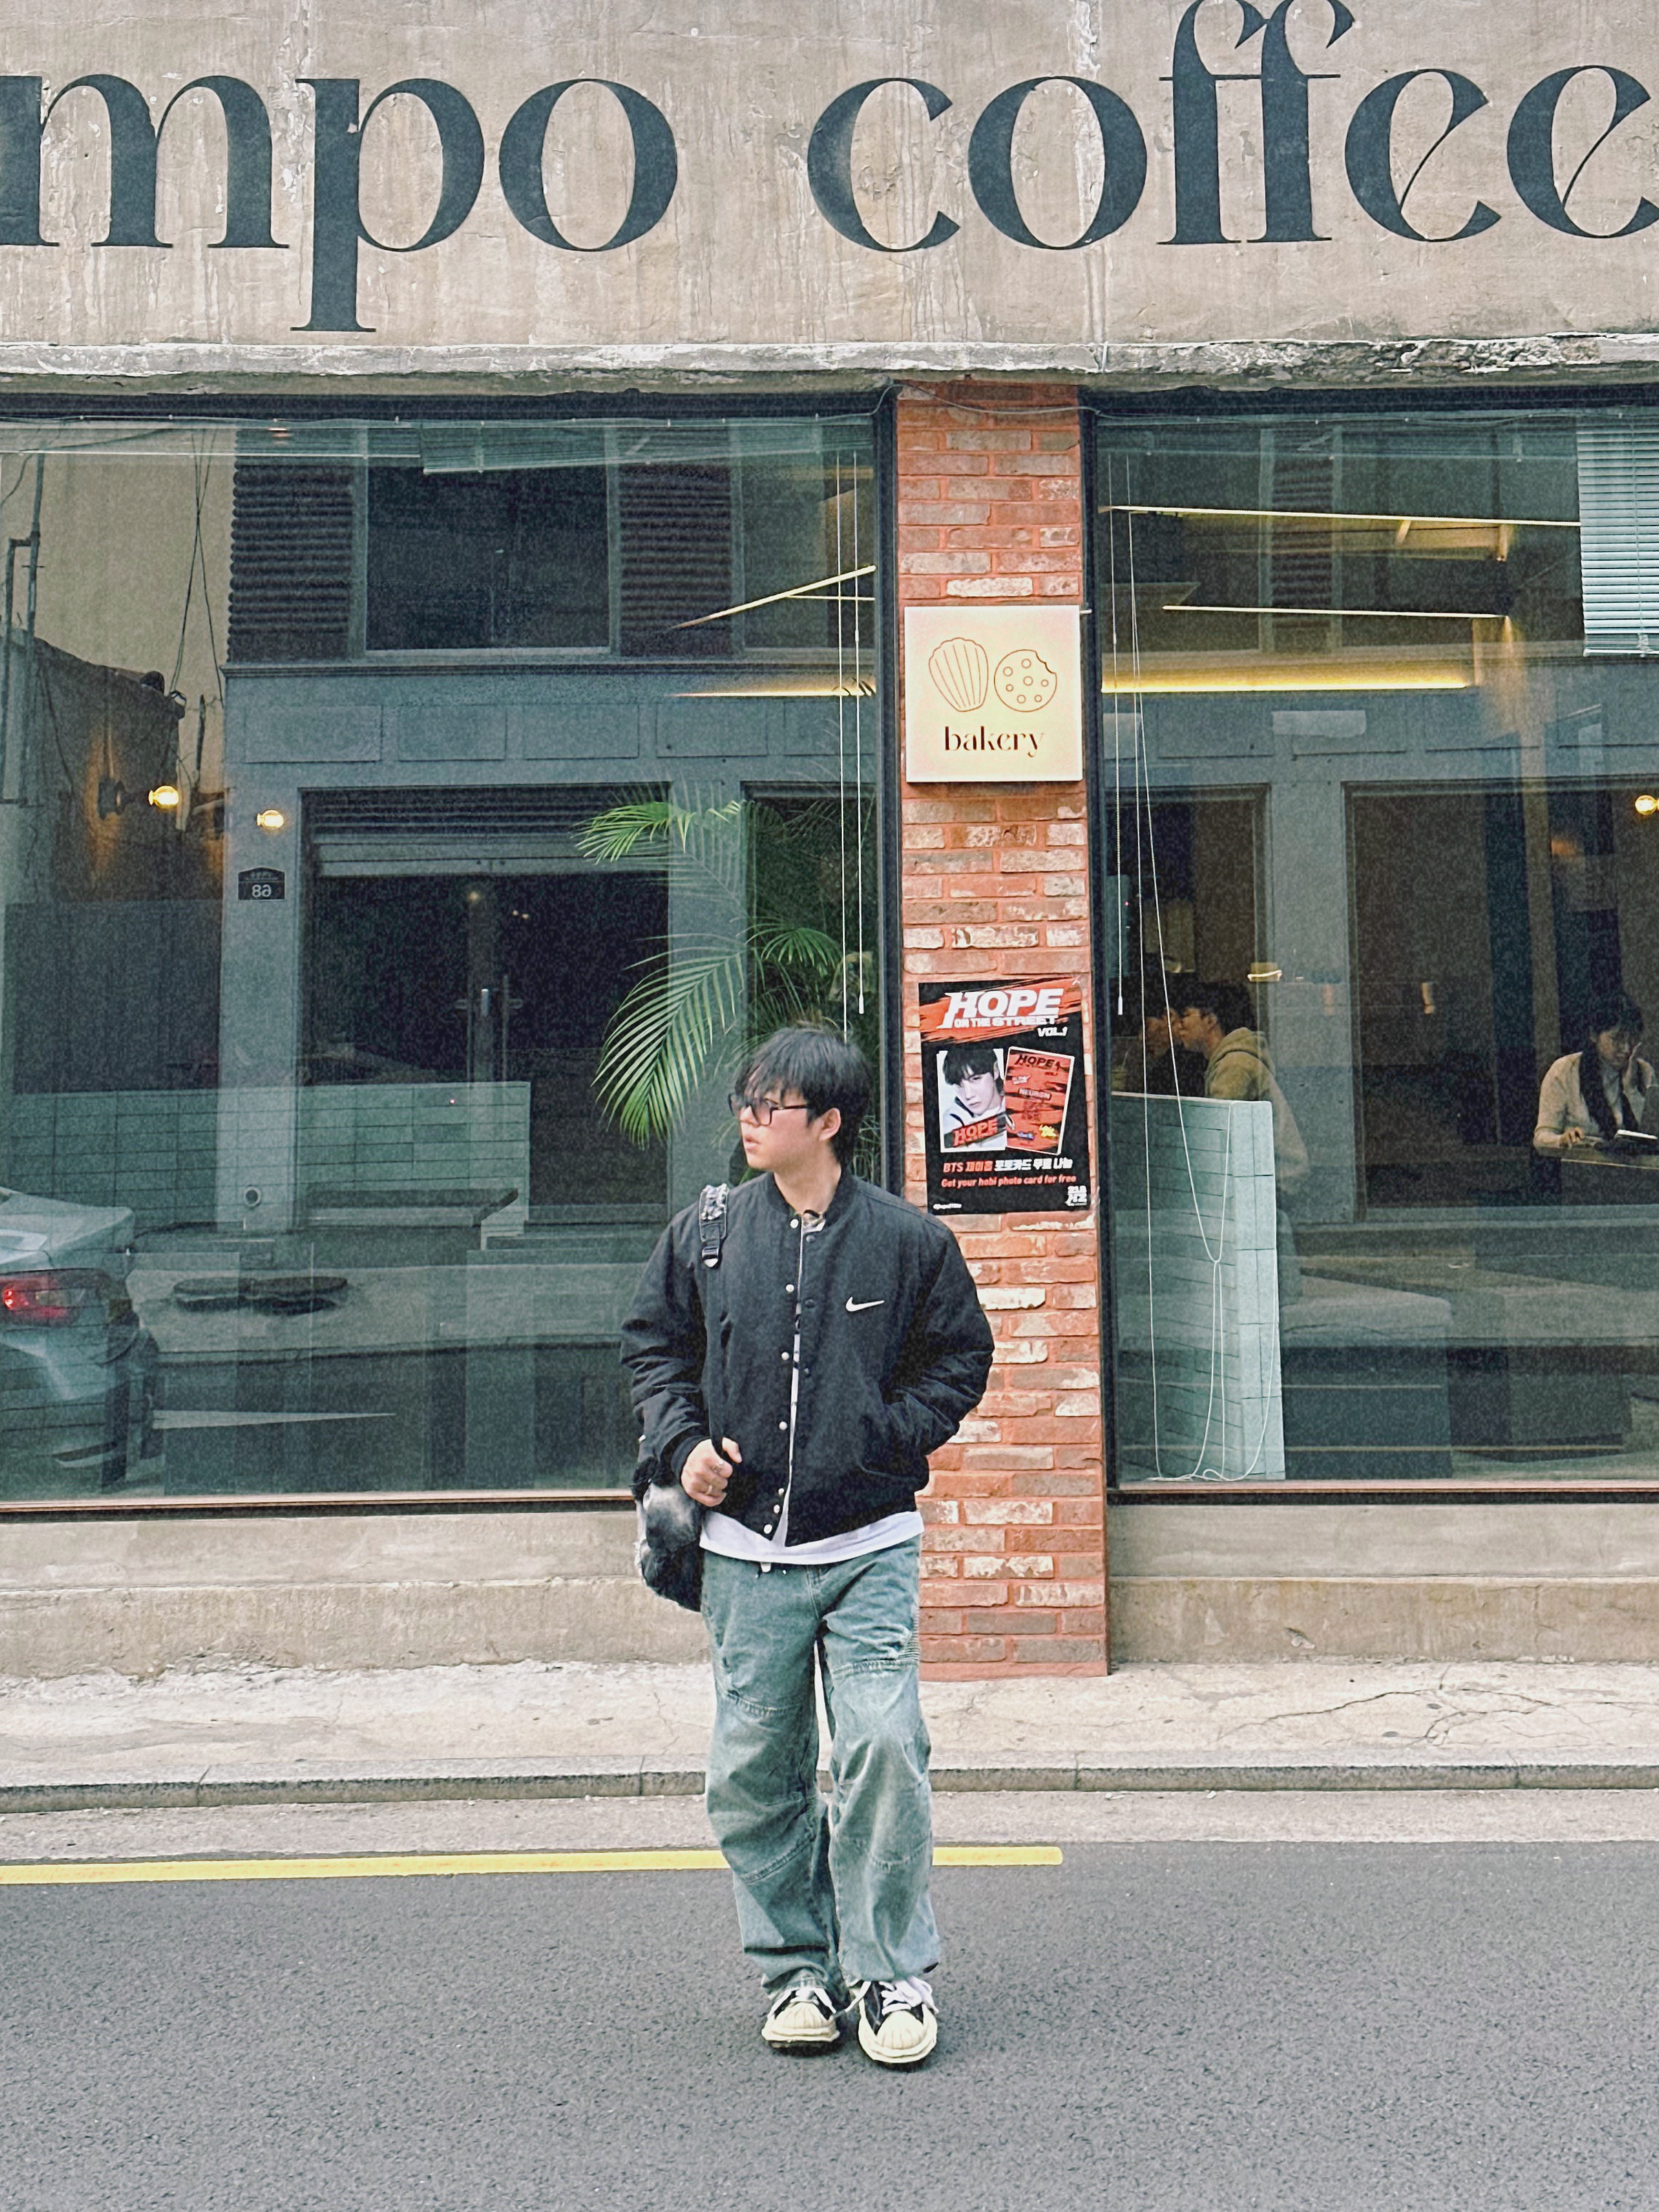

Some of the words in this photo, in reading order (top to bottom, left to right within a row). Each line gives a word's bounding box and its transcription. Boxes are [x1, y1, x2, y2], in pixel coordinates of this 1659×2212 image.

[807, 0, 1659, 252] coffee
[944, 725, 1045, 758] bakery
[936, 988, 1064, 1029] HOPE
[954, 1018, 969, 1028] ON
[971, 1018, 991, 1027] THE
[992, 1016, 1057, 1026] STREET
[1037, 1027, 1068, 1037] VOL.1
[953, 1117, 999, 1147] HOPE
[943, 1162, 964, 1173] BTS
[994, 1159, 1032, 1171] 포토카드
[1033, 1158, 1052, 1170] 무료
[941, 1178, 956, 1188] Get
[957, 1179, 977, 1189] your
[979, 1177, 997, 1186] hobi
[998, 1175, 1023, 1187] photo
[1023, 1175, 1043, 1185] card
[1044, 1175, 1056, 1184] for
[1059, 1174, 1077, 1183] free
